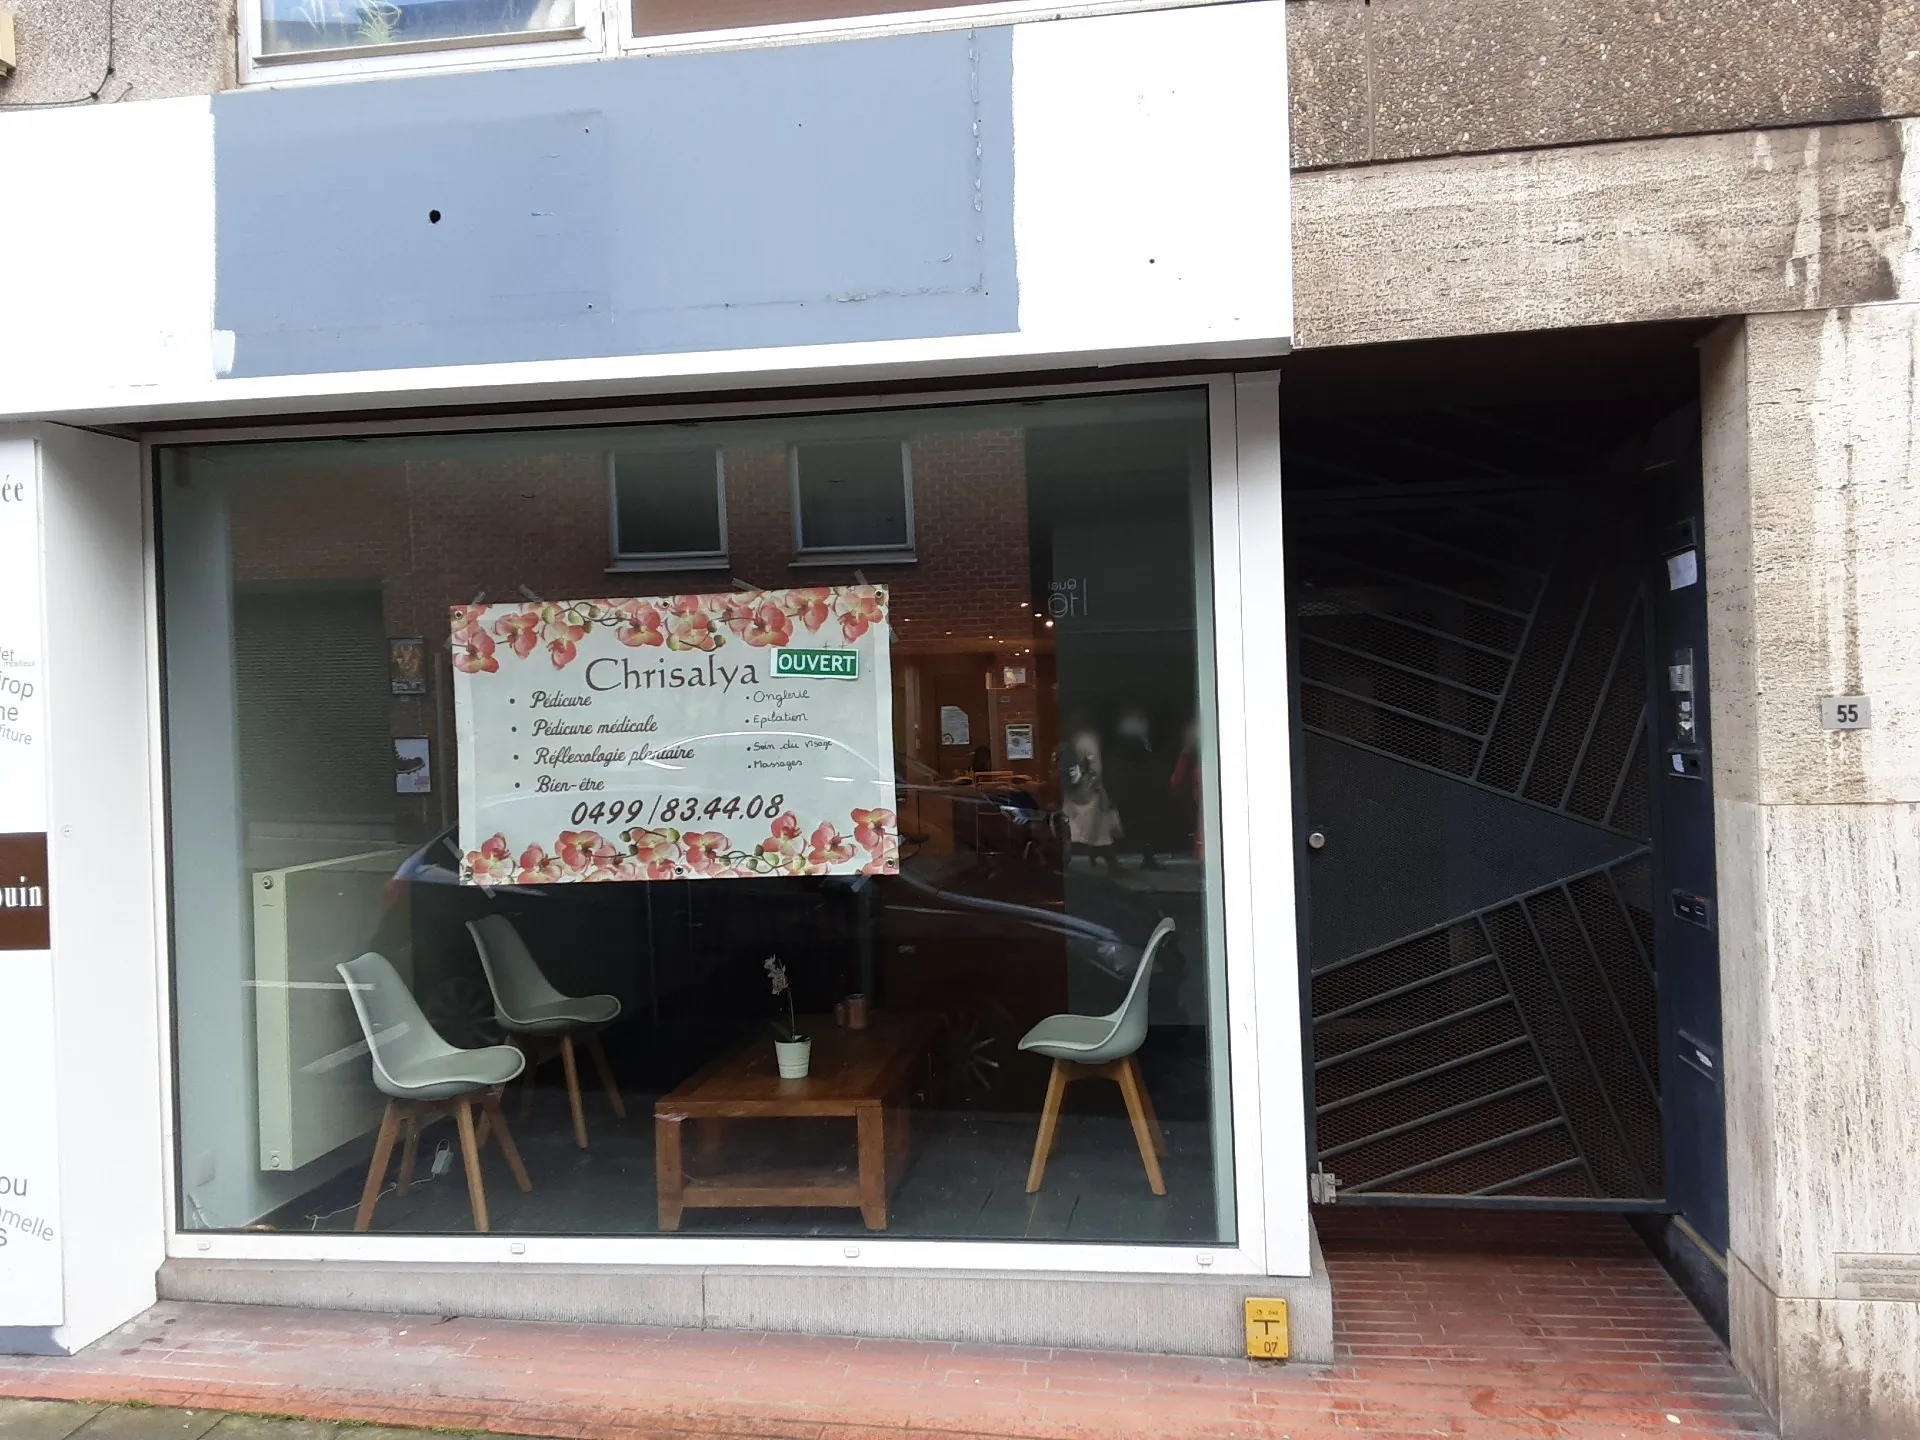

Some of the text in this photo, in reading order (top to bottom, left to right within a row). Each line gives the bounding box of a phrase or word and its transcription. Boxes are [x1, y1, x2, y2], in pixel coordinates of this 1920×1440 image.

[778, 653, 856, 673] OUVERT
[585, 654, 759, 693] Chrisalya
[0, 671, 34, 701] rop
[529, 690, 592, 709] Pédicure
[753, 690, 810, 708] Onglerie
[753, 711, 808, 728] Epilation
[1836, 704, 1859, 723] 55
[532, 714, 658, 737] Pédicure médicale
[780, 739, 800, 750] du
[533, 745, 626, 768] Réflexologie
[754, 760, 803, 771] Massages
[535, 774, 605, 793] Bien-être
[0, 875, 43, 908] uin
[0, 1206, 54, 1241] melle
[1264, 1341, 1278, 1353] 07
